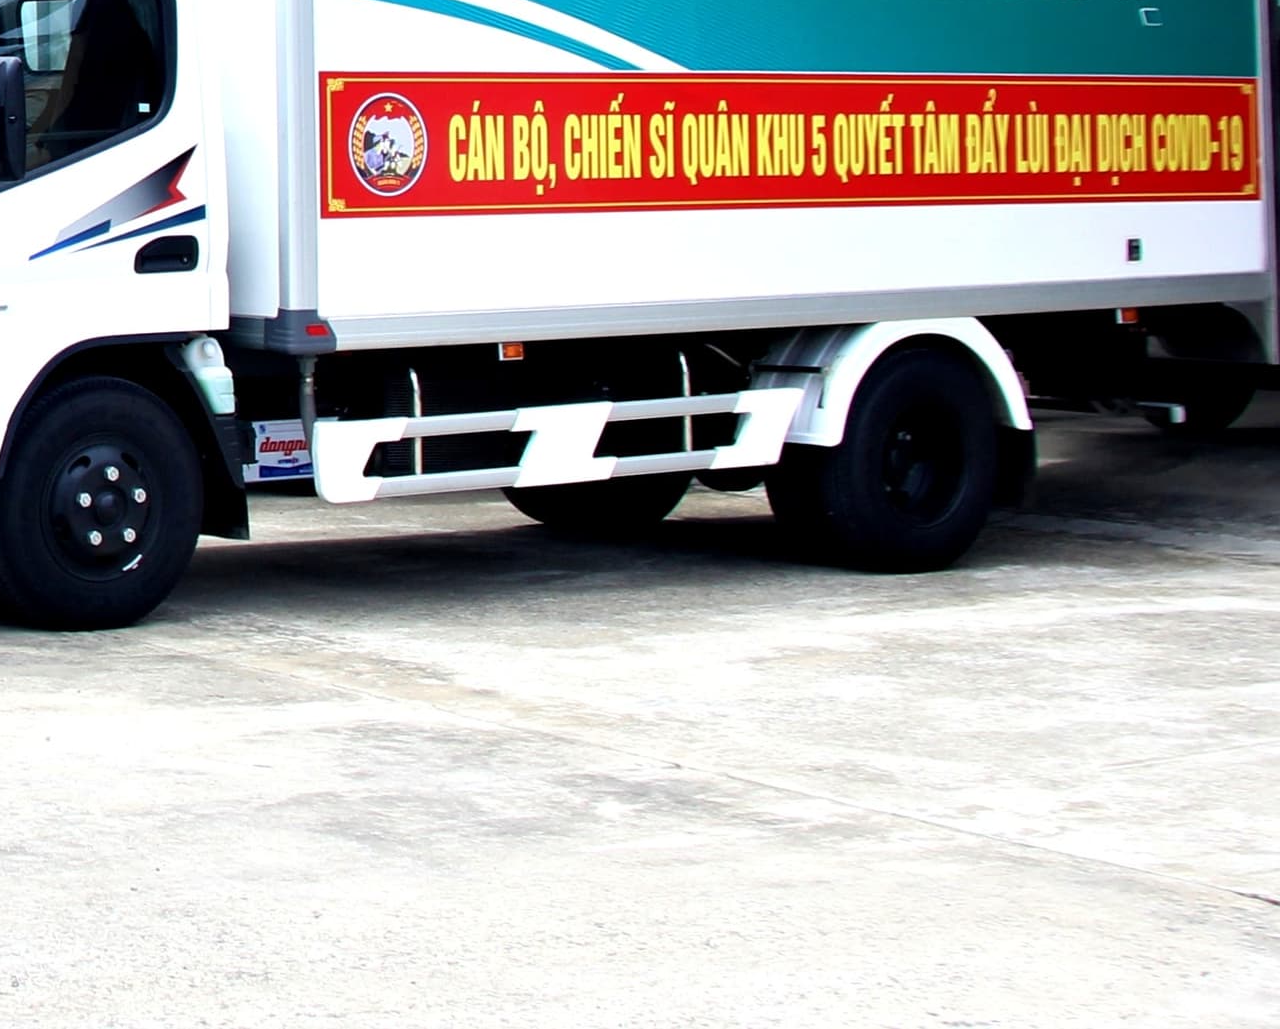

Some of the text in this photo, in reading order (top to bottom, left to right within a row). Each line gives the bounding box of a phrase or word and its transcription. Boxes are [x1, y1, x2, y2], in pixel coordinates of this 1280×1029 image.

[448, 88, 1245, 195] CÁN BỘ, CHIẾN SĨ QUÂN KHU 5 QUYẾT TÂM ĐẨY LÙI ĐẠI DỊCH COVID-19
